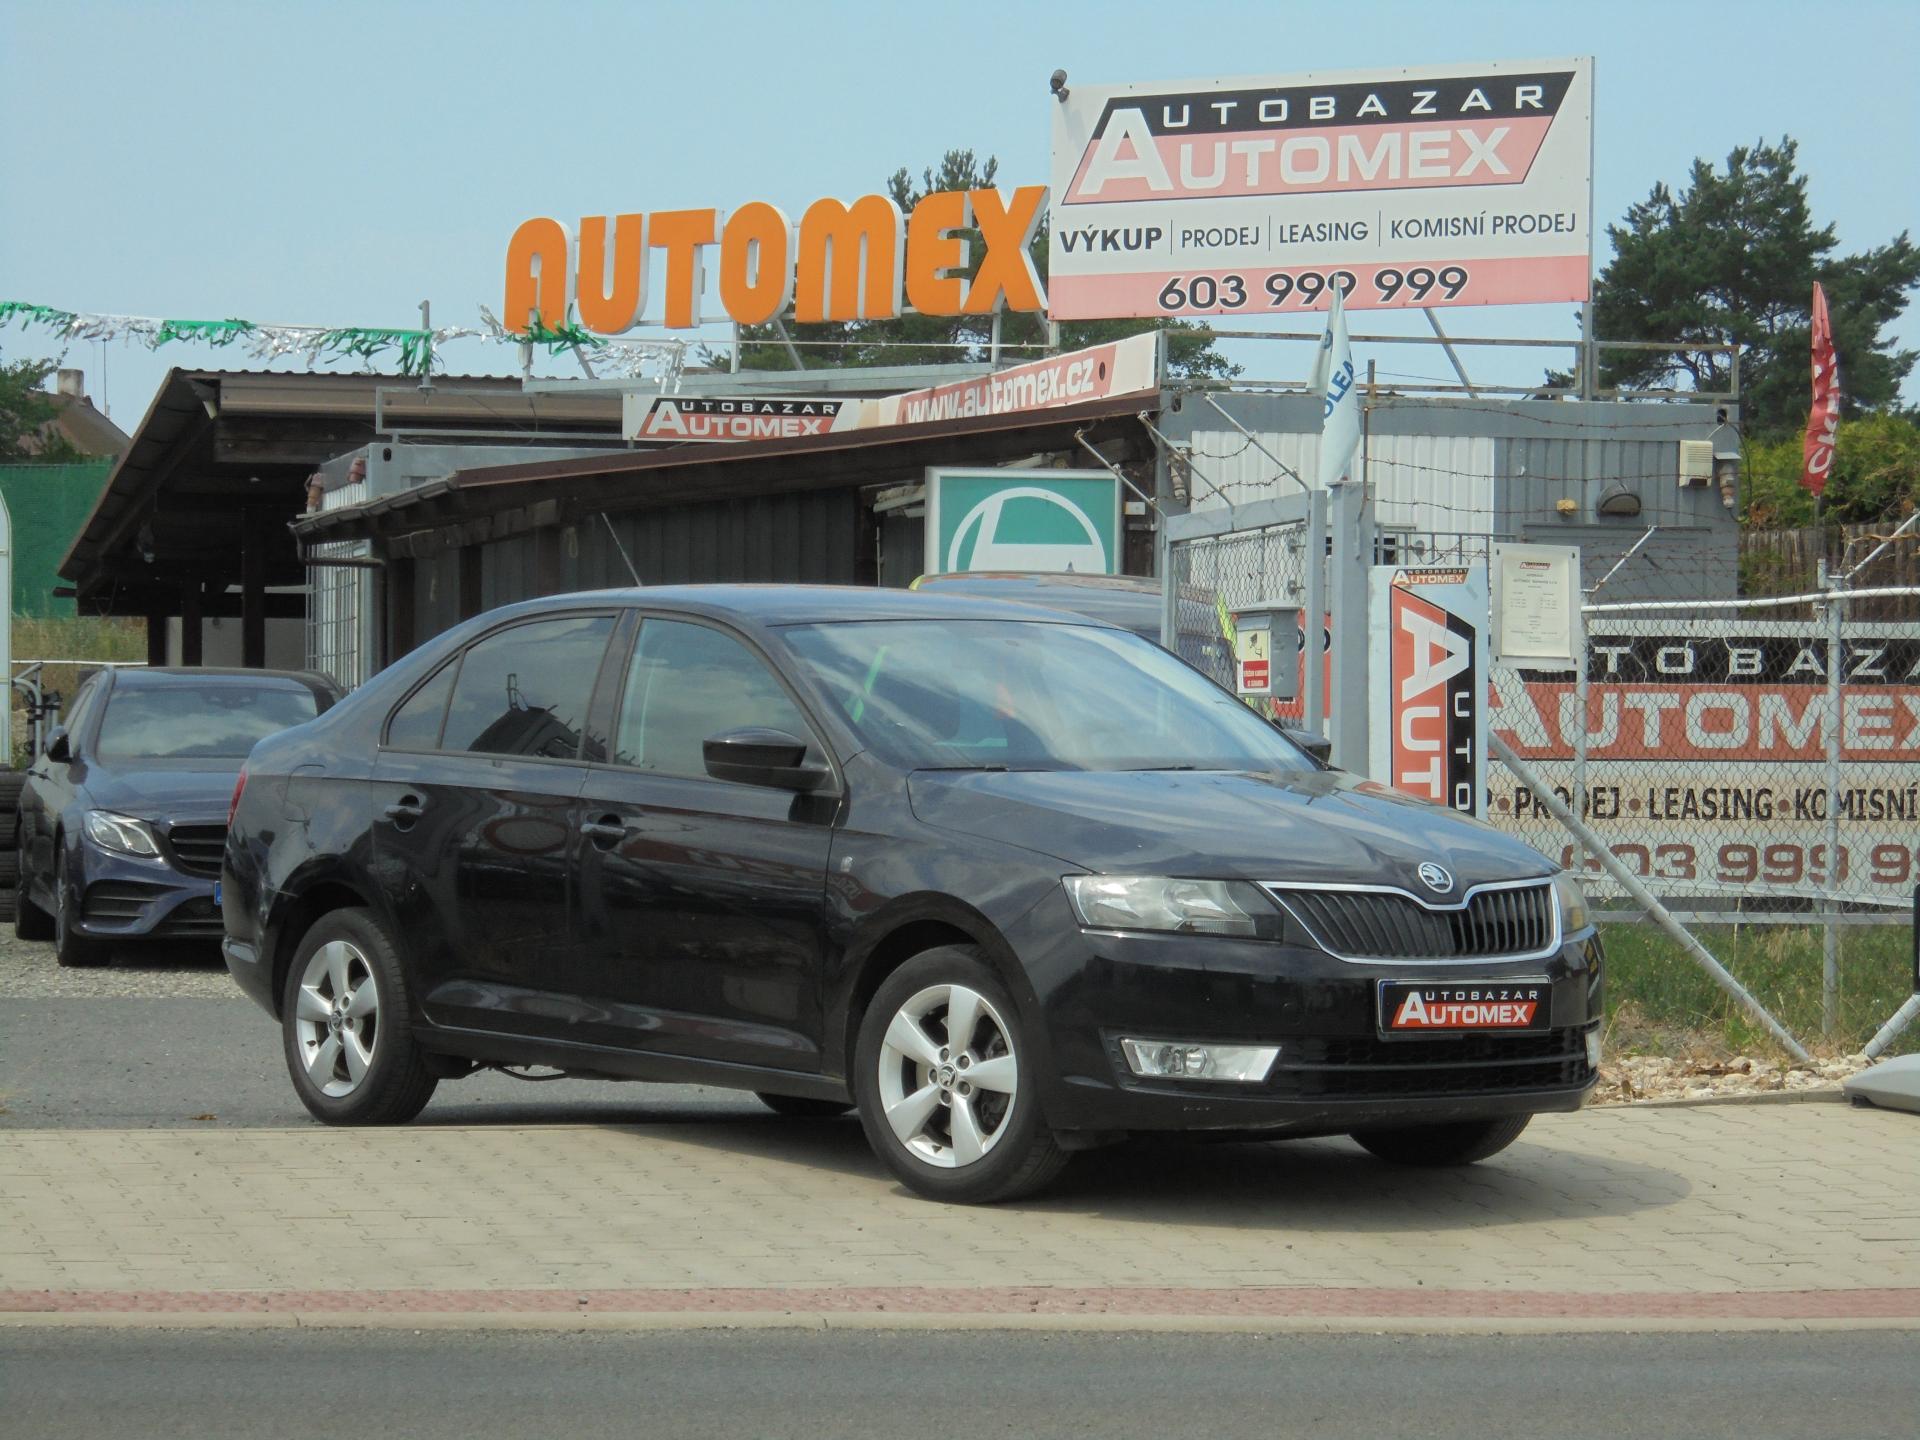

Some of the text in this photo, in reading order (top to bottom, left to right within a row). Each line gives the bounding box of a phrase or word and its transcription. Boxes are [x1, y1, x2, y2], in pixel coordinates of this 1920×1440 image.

[1077, 108, 1510, 196] AUTOMEX
[1060, 211, 1576, 253] VÝKUP PRODEJ LEASING KOMISNÍ PRODEJ
[504, 185, 1048, 336] AUTOMEX
[1158, 265, 1469, 310] 603 999 999
[907, 358, 1094, 424] www.automex.cz
[647, 401, 823, 436] AUTOMEX
[1393, 570, 1462, 584] AUTOMEX
[1649, 787, 1773, 822] LEASING
[1398, 992, 1528, 1025] AUTOMEX
